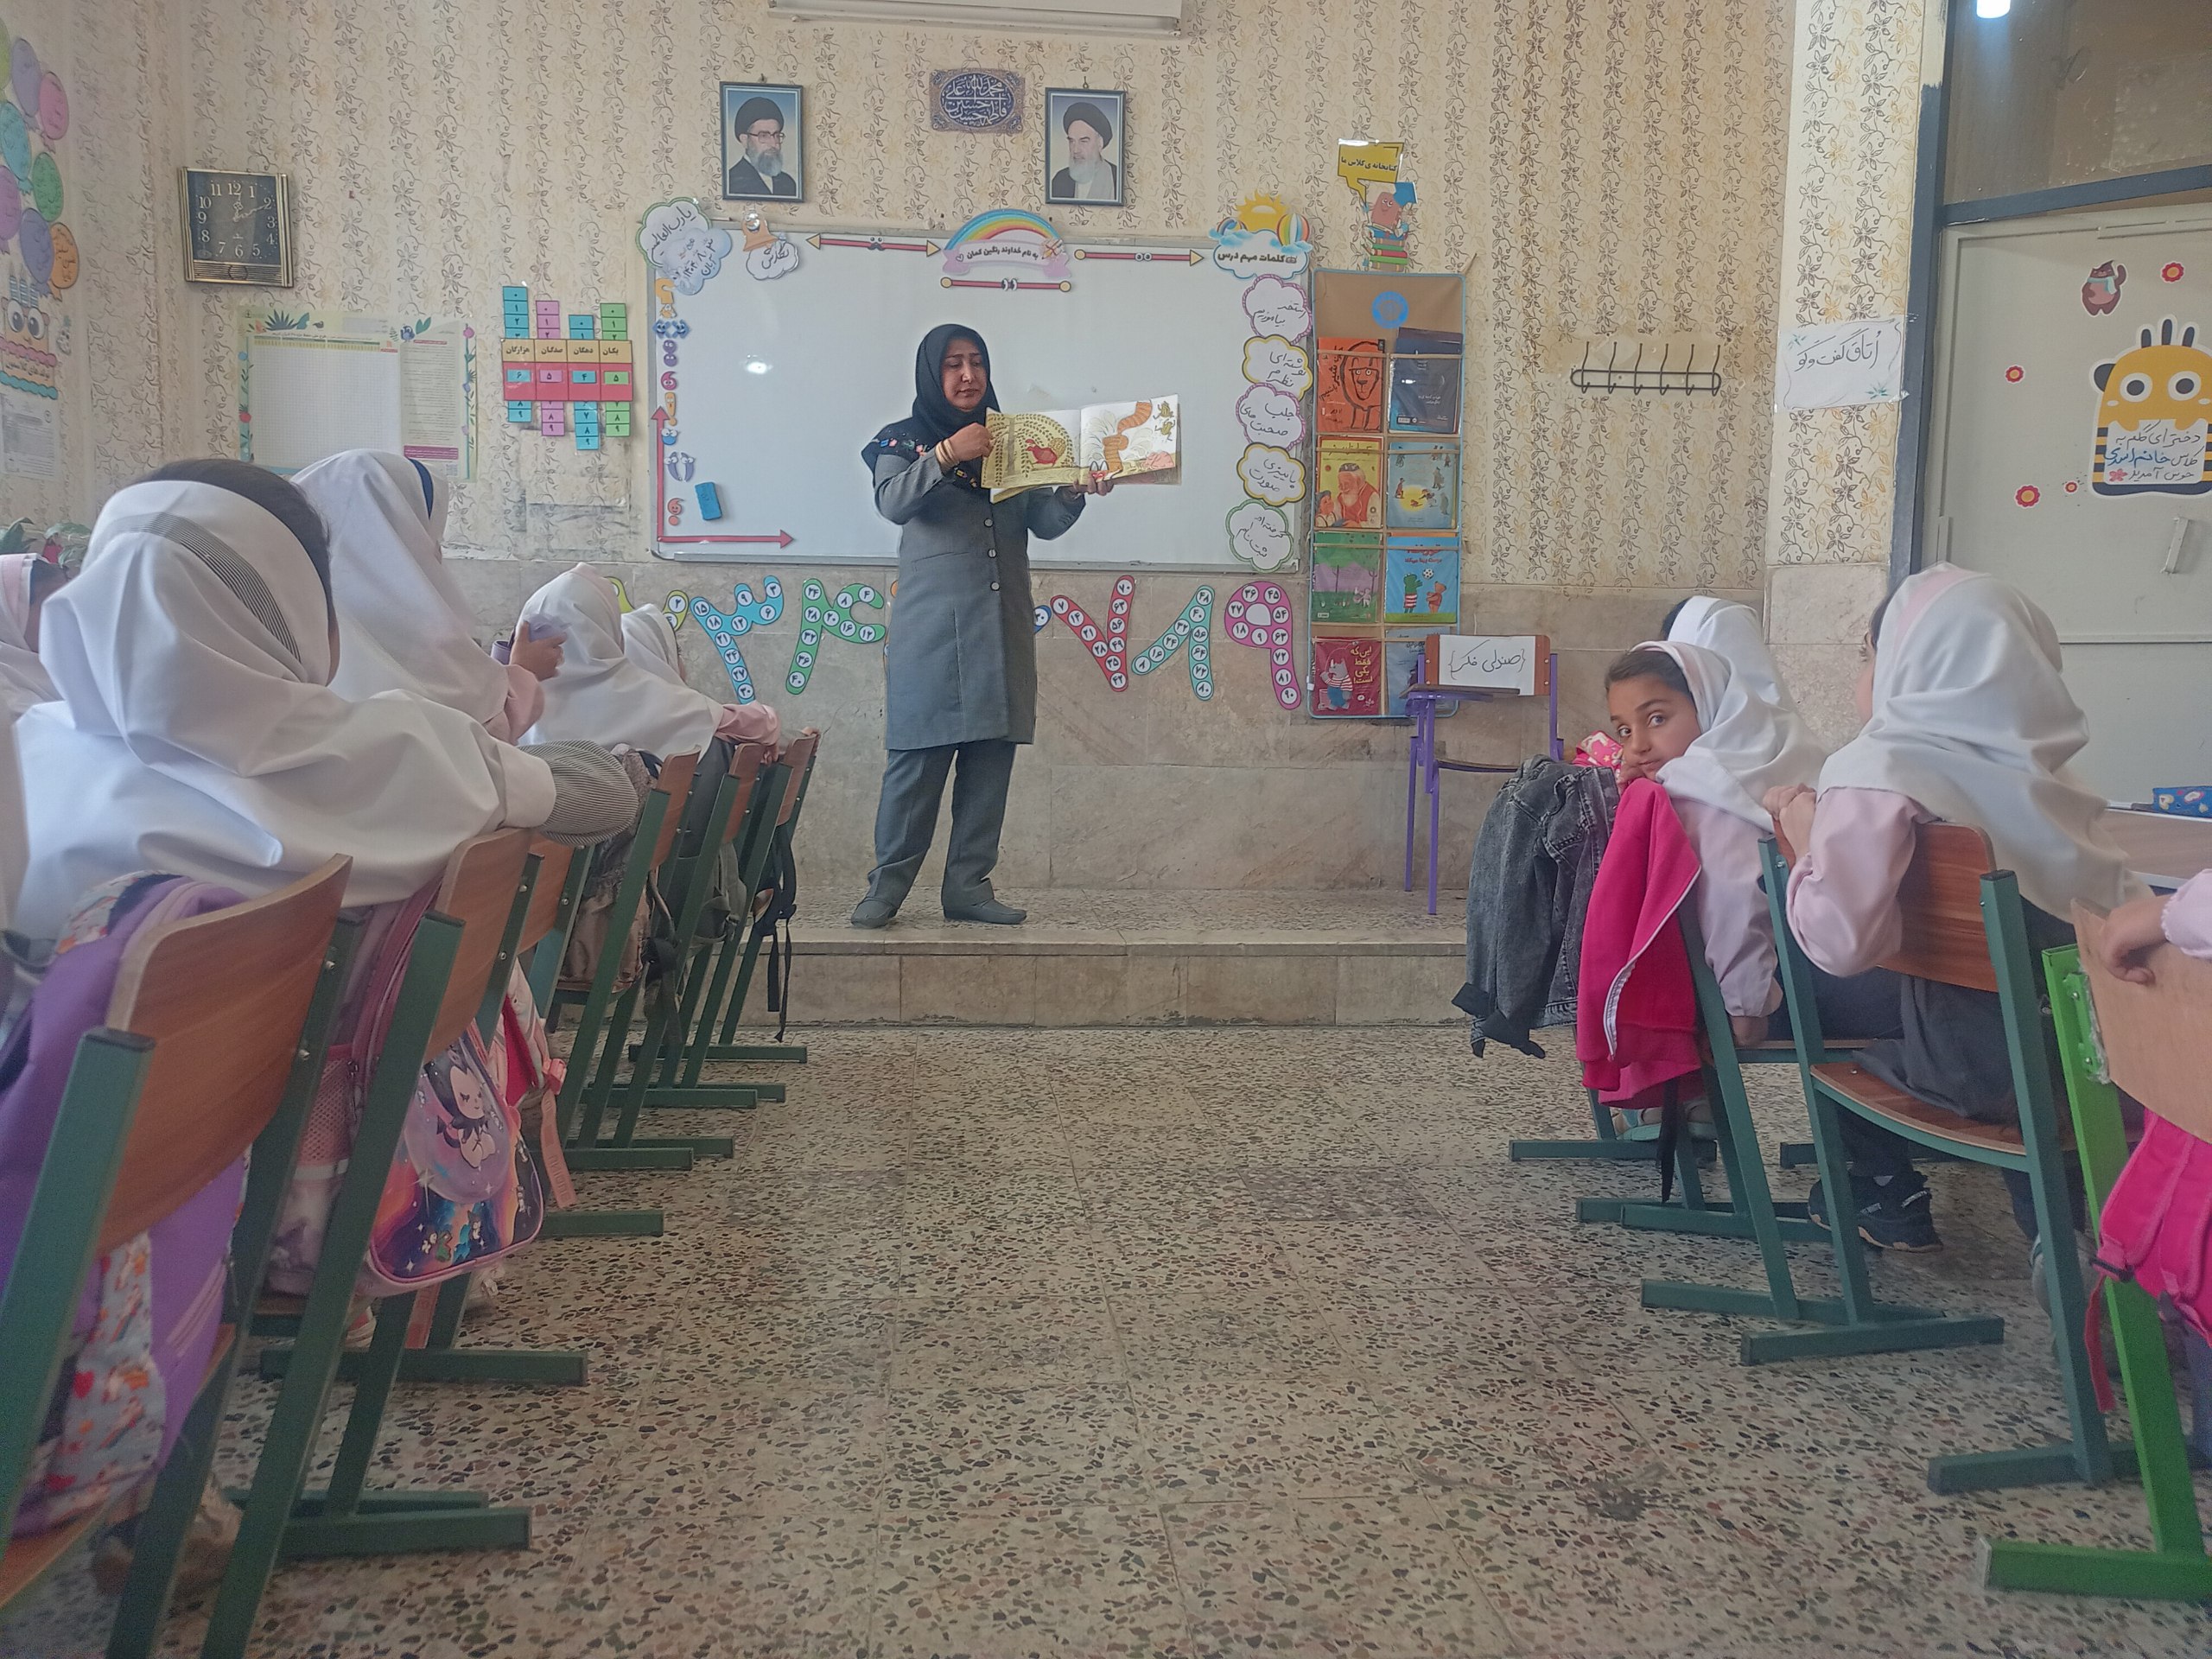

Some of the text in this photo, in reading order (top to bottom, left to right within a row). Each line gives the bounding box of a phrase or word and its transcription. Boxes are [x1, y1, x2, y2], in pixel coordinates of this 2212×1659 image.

[211, 183, 222, 196] 11
[228, 183, 241, 195] 12
[250, 186, 255, 198] 1
[200, 196, 212, 208] 10
[264, 197, 271, 209] 2
[198, 212, 207, 224] 9
[267, 216, 276, 228] 3
[201, 230, 210, 242] 8
[266, 233, 274, 245] 4
[219, 241, 226, 253] 7
[235, 245, 243, 257] 6
[252, 244, 260, 256] 5
[983, 245, 1000, 256] رنگین
[966, 249, 982, 259] کمان
[1217, 252, 1286, 263] کلمات مهم درس
[1265, 403, 1294, 421] جلب
[2171, 446, 2205, 467] کلاس
[1249, 468, 1281, 493] صورت
[809, 588, 818, 597] ۲۴
[1119, 584, 1129, 593] ۷۰
[1245, 589, 1255, 598] ۳۶
[1199, 592, 1209, 602] ۴۸
[1268, 590, 1279, 599] ۴۵
[696, 604, 707, 613] ۱۵
[1115, 601, 1124, 612] ۶۳
[1231, 605, 1242, 613] ۲۷
[809, 610, 817, 620] ۲۸
[1071, 613, 1080, 622] ۱۴
[1275, 610, 1286, 619] ۵۴
[709, 618, 720, 626] ۱۸
[734, 619, 743, 628] ۱۲
[1112, 620, 1122, 630] ۵۶
[1177, 622, 1187, 632] ۳۲
[843, 623, 852, 632] ۱۶
[804, 632, 816, 641] ۳۲
[862, 630, 872, 639] ۱۲
[1084, 629, 1093, 638] ۲۱
[1275, 632, 1286, 641] ۶۳
[717, 634, 728, 644] ۲۱
[1166, 638, 1177, 646] ۲۴
[1095, 645, 1106, 654] ۲۸
[1112, 640, 1123, 650] ۴۹
[727, 652, 739, 661] ۲۴
[1153, 649, 1161, 658] ۱۶
[1194, 648, 1205, 657] ۶۴
[1451, 639, 1491, 673] فکر
[798, 655, 809, 664] ۳۶
[1108, 658, 1118, 667] ۳۵
[1354, 658, 1371, 666] فقط
[1482, 649, 1522, 673] صندلی
[734, 670, 744, 679] ۲۷
[1196, 666, 1206, 676] ۷۲
[1355, 666, 1370, 677] یکی
[1113, 676, 1122, 684] ۴۲
